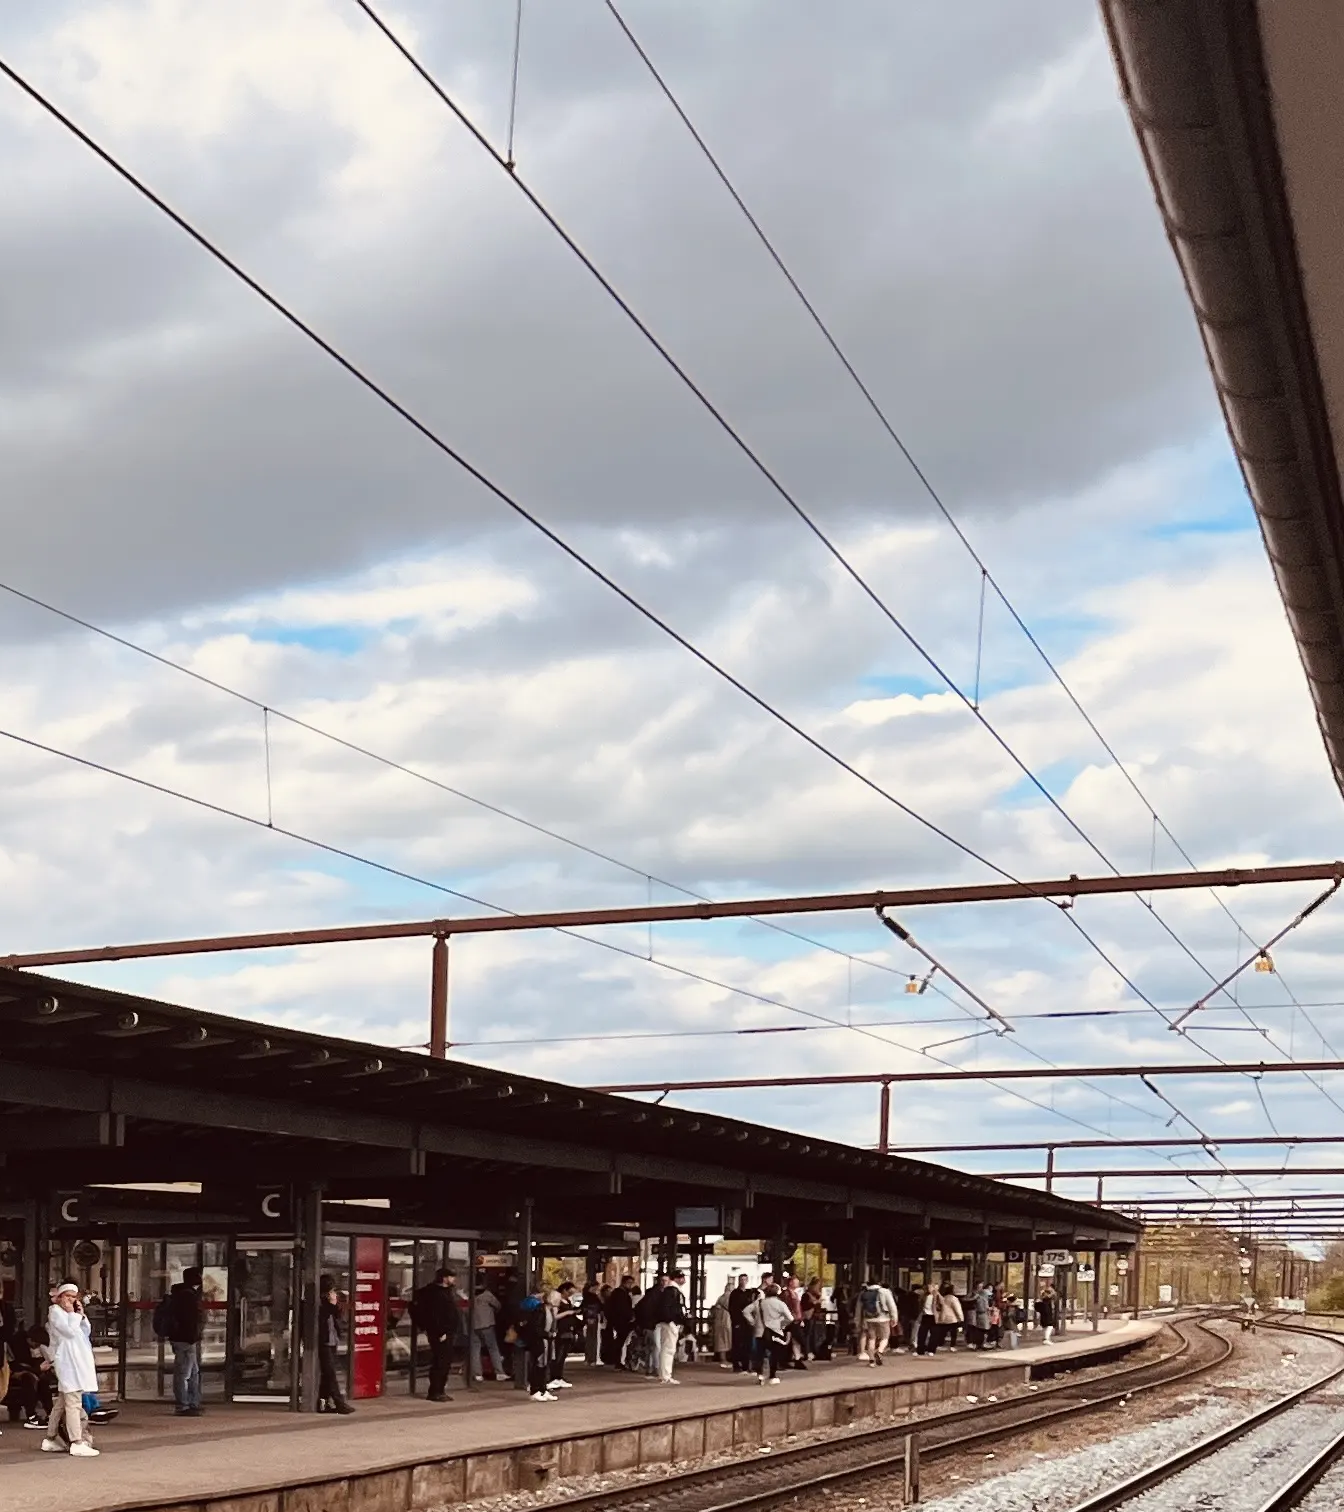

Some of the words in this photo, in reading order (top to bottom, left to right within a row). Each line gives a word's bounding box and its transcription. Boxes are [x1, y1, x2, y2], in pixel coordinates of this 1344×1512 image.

[61, 1198, 79, 1222] C
[262, 1193, 281, 1218] C
[1008, 1250, 1020, 1261] D
[1046, 1252, 1066, 1262] 175
